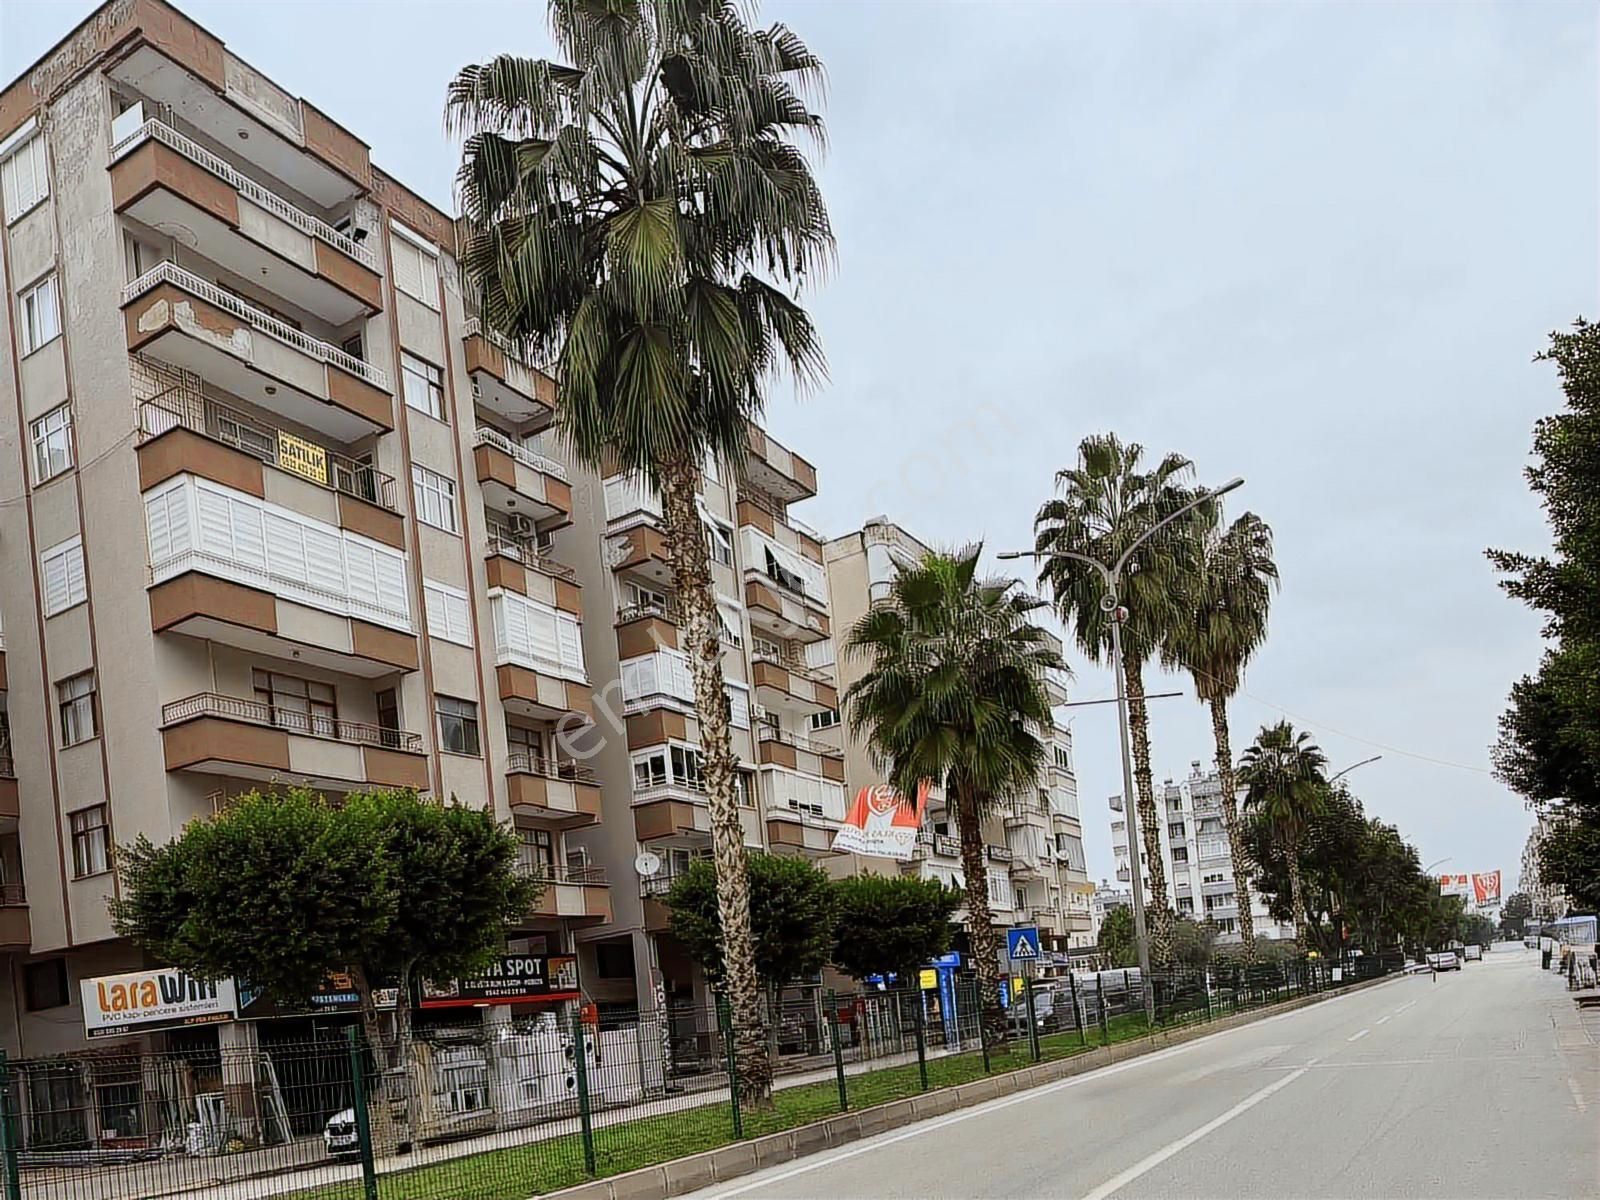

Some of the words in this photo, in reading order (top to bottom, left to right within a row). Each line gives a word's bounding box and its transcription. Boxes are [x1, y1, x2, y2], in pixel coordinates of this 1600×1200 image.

[281, 439, 324, 470] SATILIK
[506, 959, 542, 976] SPOT
[102, 1012, 121, 1022] PVC
